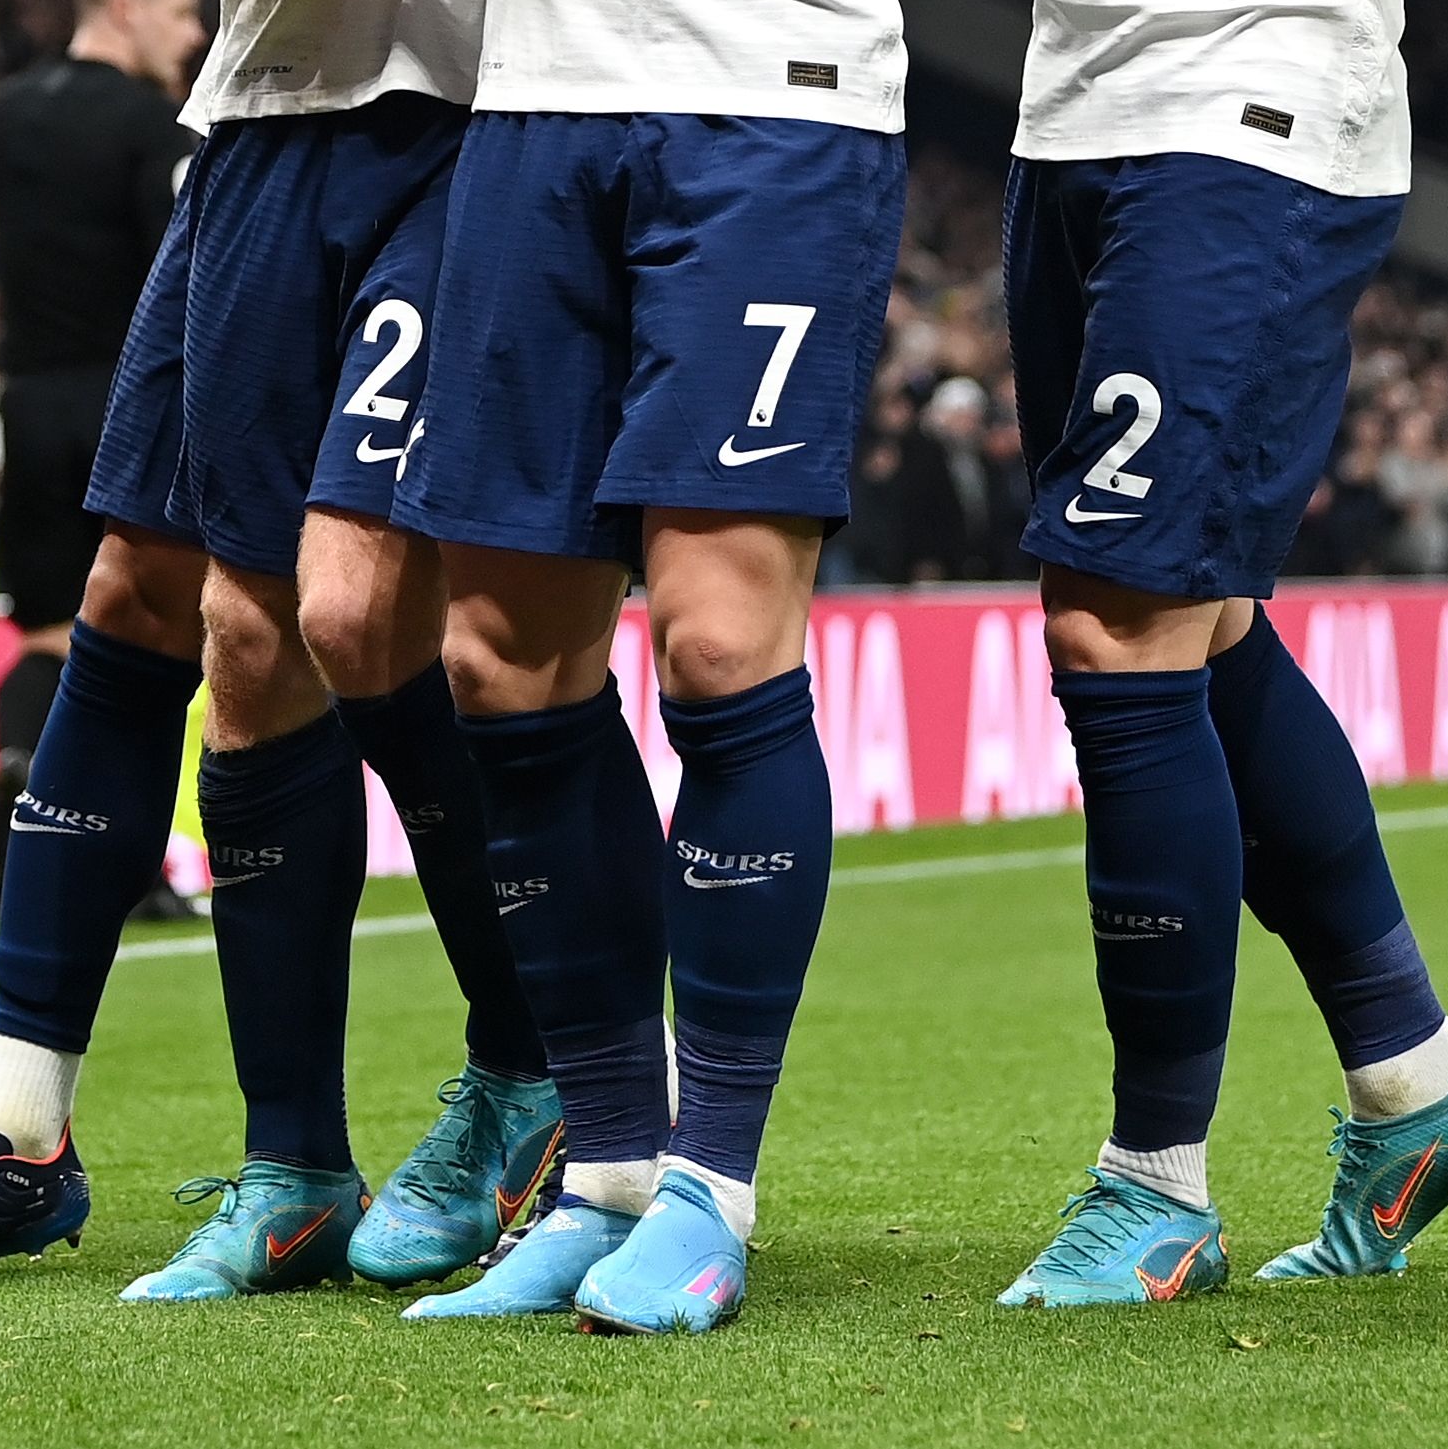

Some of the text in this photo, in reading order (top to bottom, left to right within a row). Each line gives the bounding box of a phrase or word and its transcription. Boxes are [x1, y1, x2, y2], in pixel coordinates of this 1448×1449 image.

[744, 303, 816, 427] 7
[1082, 372, 1163, 499] 2
[804, 610, 917, 833] IA
[213, 846, 284, 867] URS
[677, 839, 795, 871] SPURS
[6, 1171, 30, 1187] COPA
